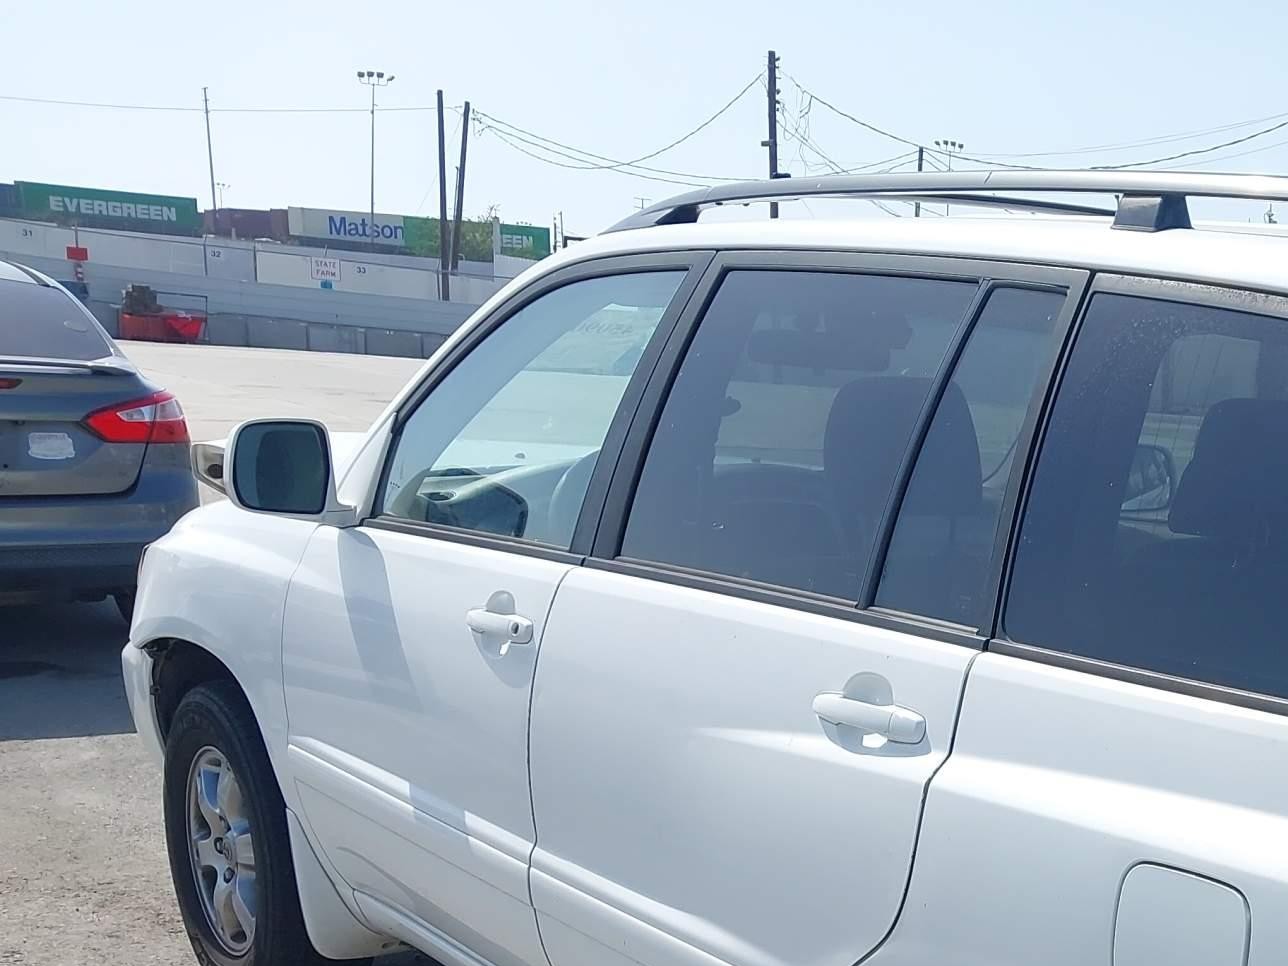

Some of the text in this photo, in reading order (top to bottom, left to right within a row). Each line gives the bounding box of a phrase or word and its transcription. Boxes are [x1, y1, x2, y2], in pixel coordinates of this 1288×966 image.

[49, 196, 177, 221] EVERGREEN
[328, 215, 404, 240] Matson
[22, 229, 33, 237] 31
[211, 250, 222, 258] 32
[315, 260, 337, 269] STATE
[316, 268, 337, 278] FARM
[356, 266, 367, 274] 33
